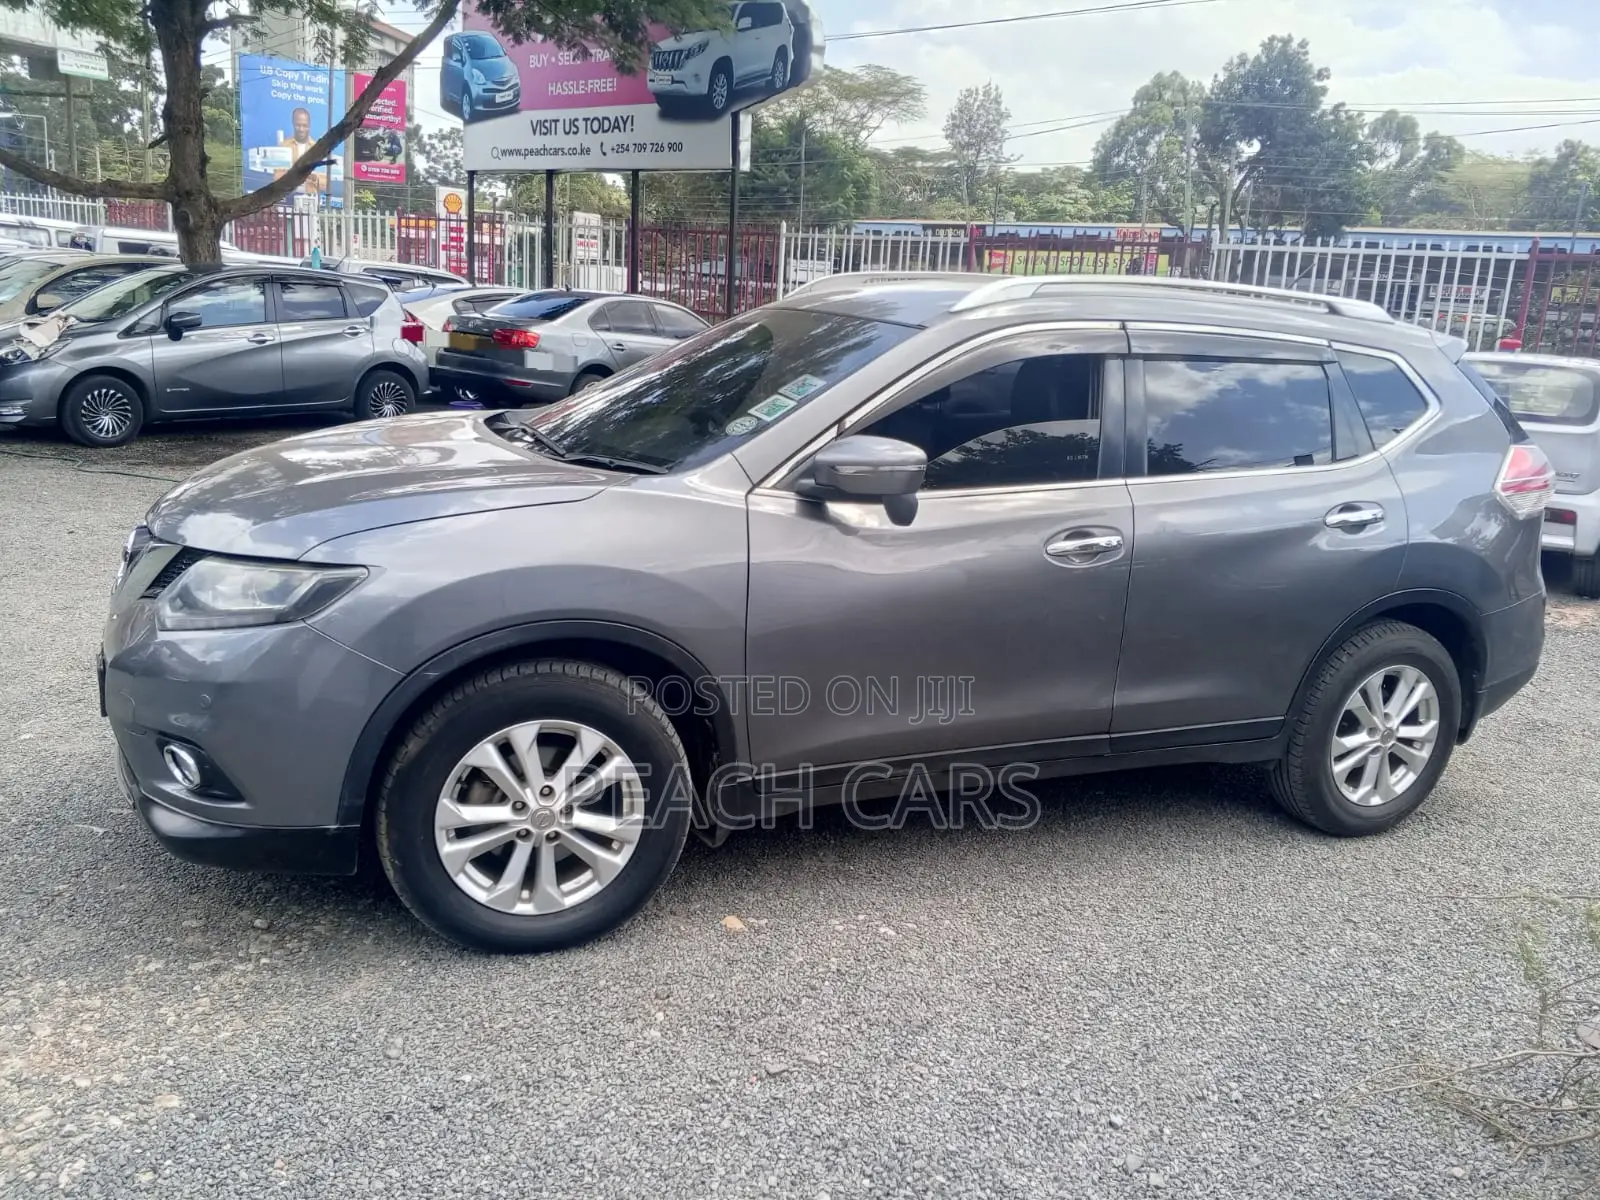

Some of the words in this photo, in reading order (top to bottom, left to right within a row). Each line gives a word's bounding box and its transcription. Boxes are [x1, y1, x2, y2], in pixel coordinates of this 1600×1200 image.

[529, 53, 549, 68] BUY
[275, 67, 300, 81] Copy
[302, 71, 329, 84] Tradin
[271, 79, 289, 90] Skip
[290, 82, 304, 92] the
[548, 77, 617, 96] HASSLE-FREE!
[271, 89, 292, 101] Copy
[293, 92, 307, 102] the
[369, 105, 395, 115] erified.
[530, 118, 560, 136] VISIT
[562, 117, 580, 136] US
[582, 115, 635, 135] TODAY!
[501, 142, 591, 160] www.peachcars.co.ke
[611, 144, 630, 154] +254
[632, 143, 648, 153] 709
[650, 143, 665, 153] 726
[667, 142, 683, 152] 900
